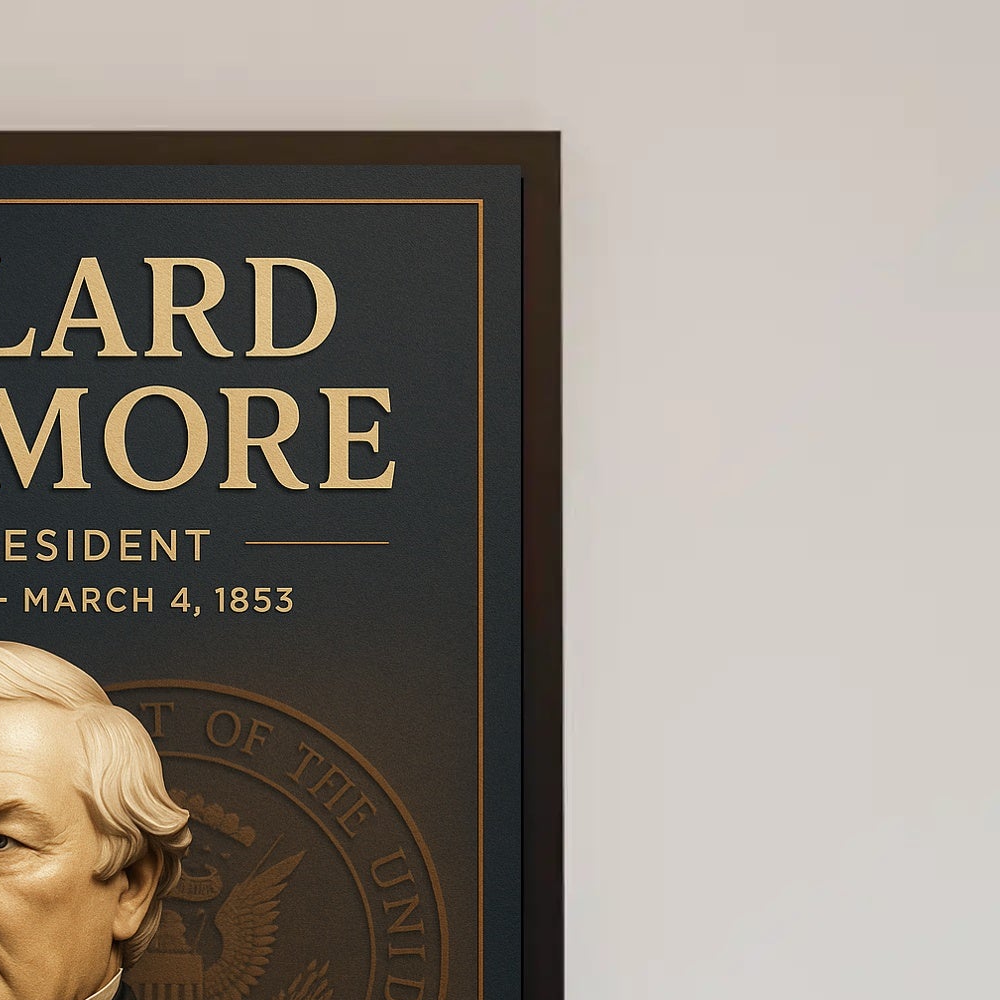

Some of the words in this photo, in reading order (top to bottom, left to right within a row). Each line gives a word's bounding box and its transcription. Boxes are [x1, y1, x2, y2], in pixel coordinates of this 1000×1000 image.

[24, 586, 153, 613] MARCH
[170, 587, 201, 618] 4,
[214, 586, 294, 613] 1853
[206, 709, 274, 755] OF
[286, 742, 378, 839] THE
